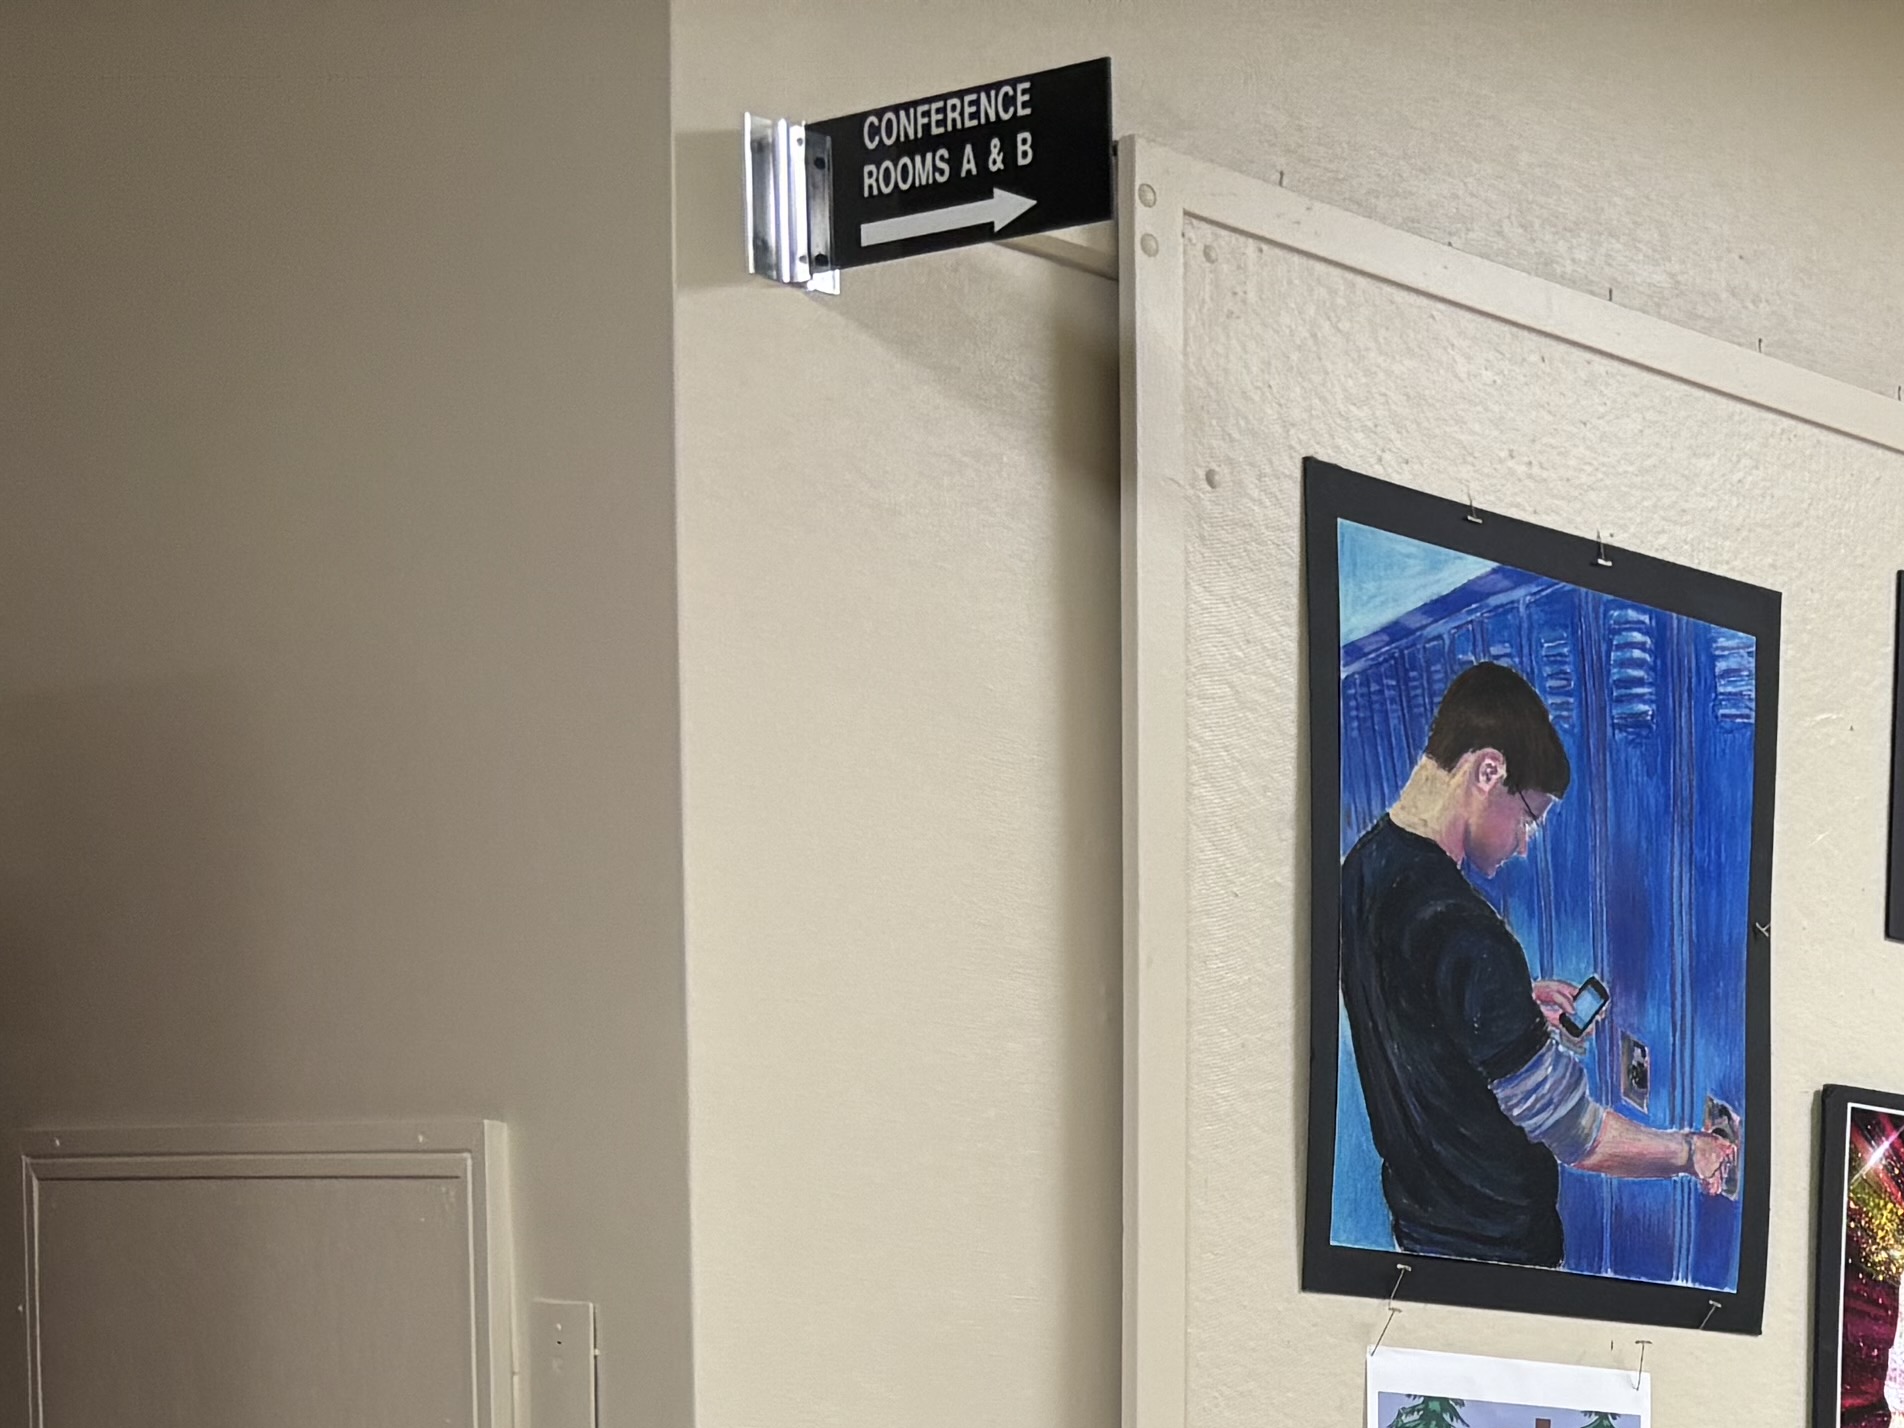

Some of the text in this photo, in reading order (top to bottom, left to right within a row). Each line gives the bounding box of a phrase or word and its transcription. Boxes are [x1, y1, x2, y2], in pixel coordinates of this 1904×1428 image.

[863, 82, 1033, 150] CONFERENCE
[863, 132, 1034, 198] ROOMS A & B
